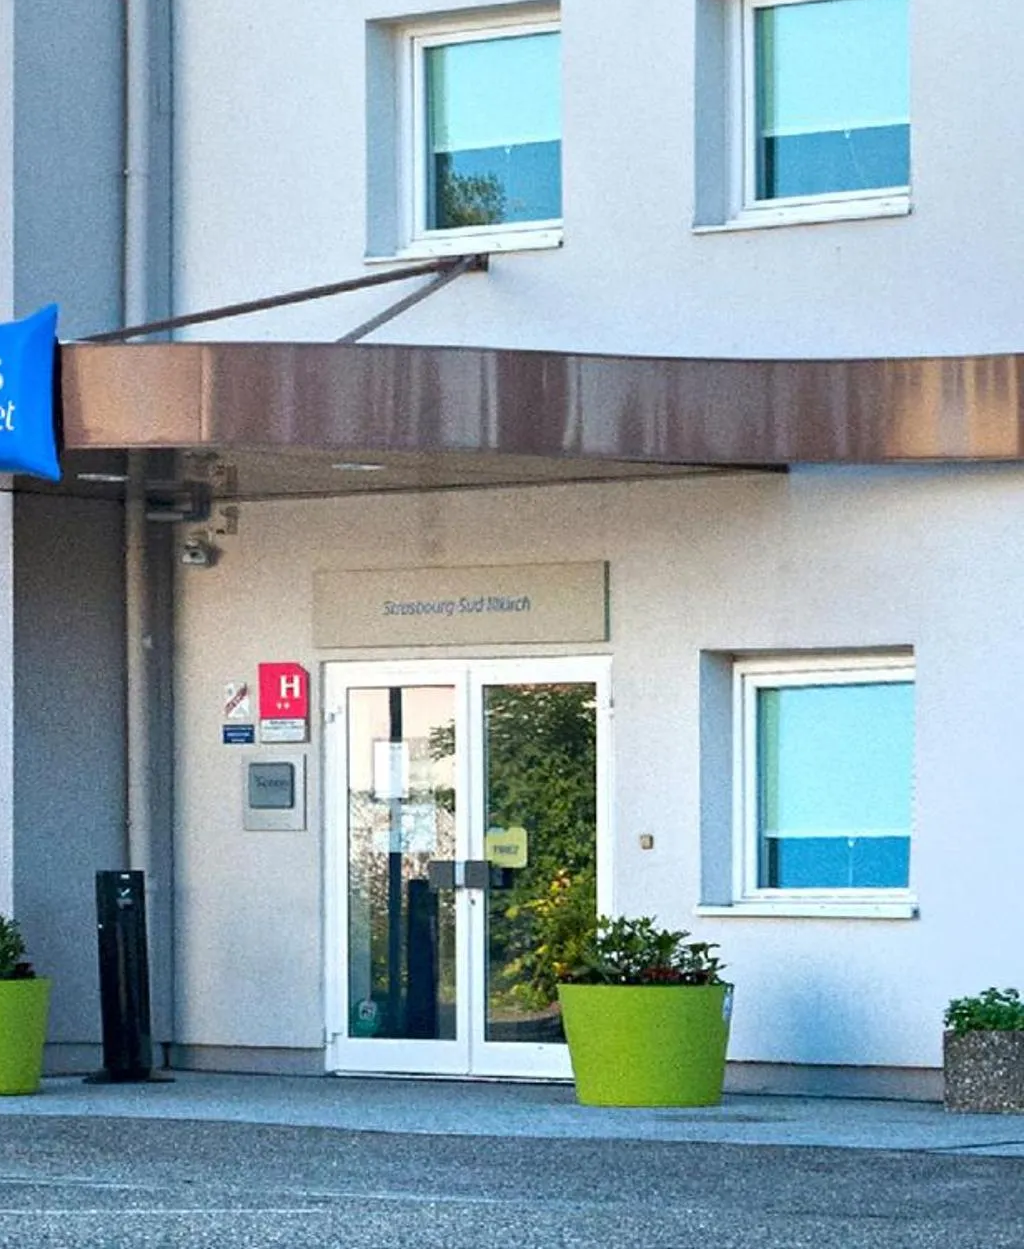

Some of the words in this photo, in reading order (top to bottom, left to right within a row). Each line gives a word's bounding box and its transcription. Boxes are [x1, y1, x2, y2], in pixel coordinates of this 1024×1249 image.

[381, 600, 455, 618] Strasbourg
[458, 596, 485, 614] Sud
[279, 674, 302, 699] H
